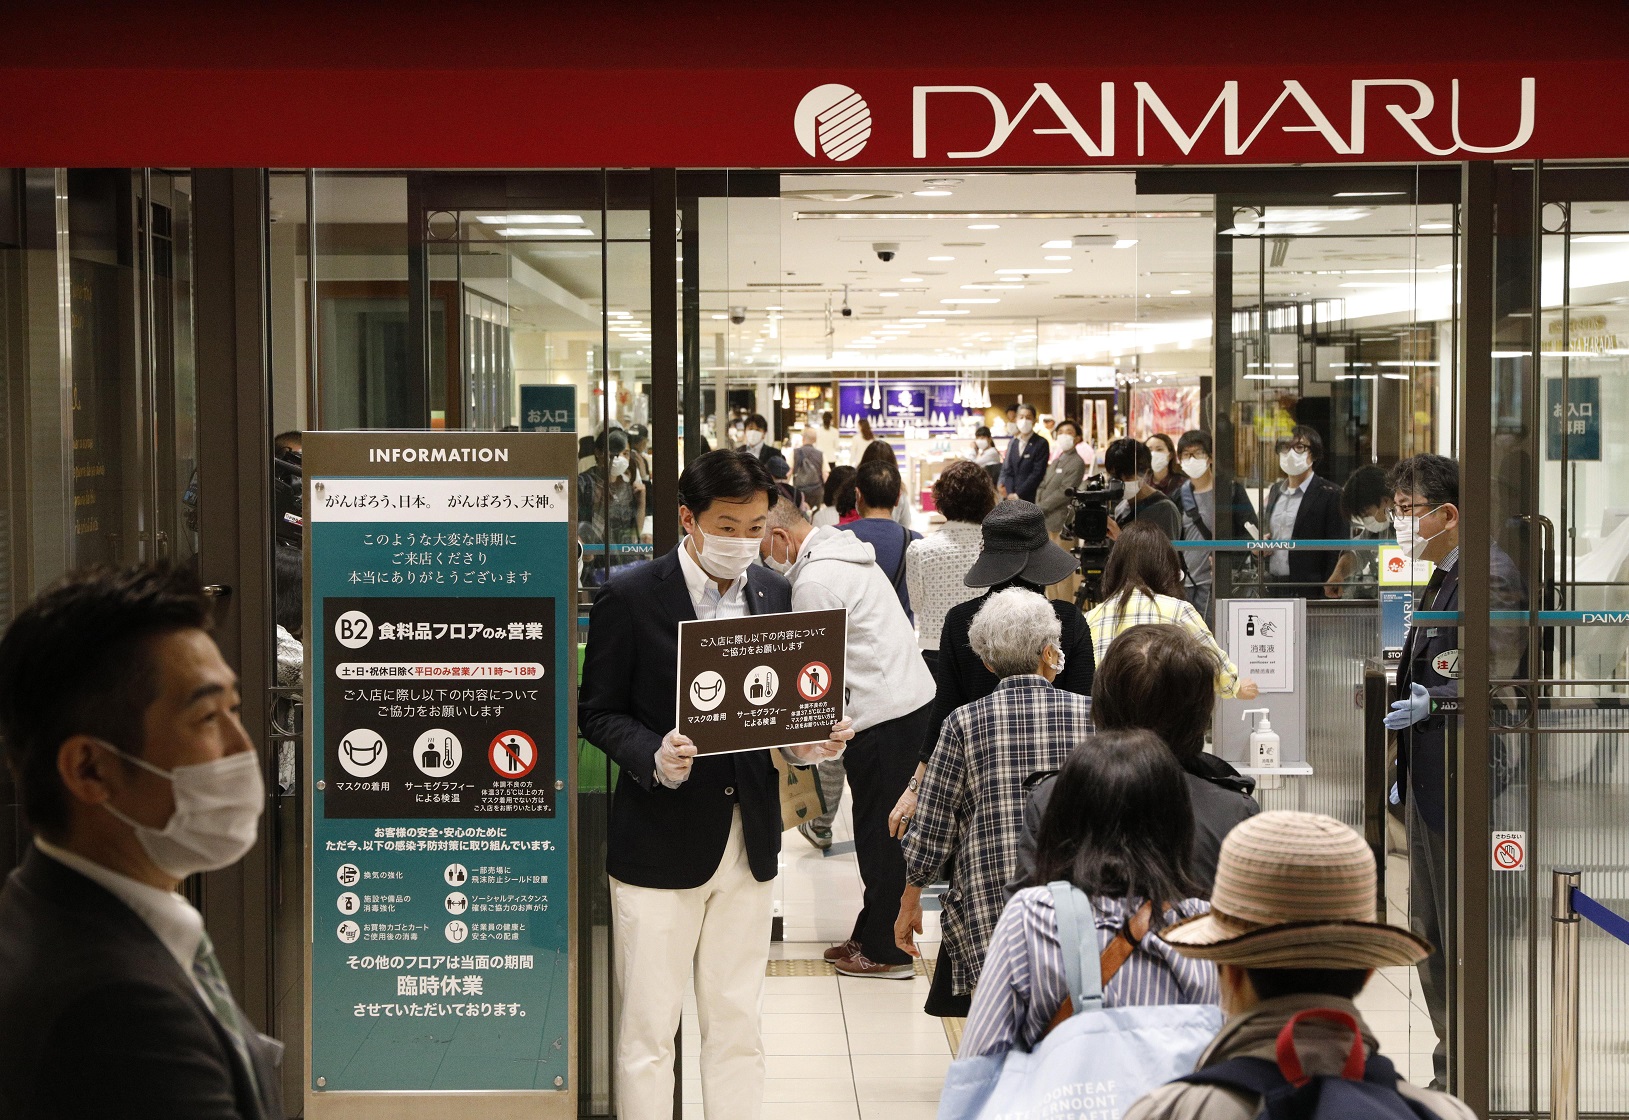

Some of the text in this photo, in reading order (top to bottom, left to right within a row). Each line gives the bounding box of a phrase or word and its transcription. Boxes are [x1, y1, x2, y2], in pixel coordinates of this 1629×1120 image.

[913, 77, 1536, 158] DAIMARU
[528, 410, 568, 423] お入口
[369, 448, 508, 462] INFORMATION
[326, 495, 554, 509] がんばろう、日本。 がんばろう、天神。
[364, 533, 517, 546] このような大変な時期に
[391, 552, 487, 565] ご来店くださり
[348, 571, 532, 584] 本当にありがとうございます
[341, 619, 543, 640] B2 食料品フロアのみ営業
[700, 628, 826, 647] ご入店に際し以下の内容について
[722, 641, 804, 657] ご協力をお願いします
[1250, 644, 1275, 653] 消毒液
[344, 689, 538, 702] ご入店に際し以下の内容について
[378, 705, 505, 717] ご協力をお願いします
[736, 707, 787, 718] サーモグラフィー
[687, 713, 727, 723] マスクの着用
[744, 718, 777, 728] による検温
[336, 782, 390, 791] マスクの着用
[405, 782, 474, 791] サーモグラフィー
[415, 793, 460, 803] による検温
[374, 827, 507, 838] お客様の安全・安心のために
[326, 840, 555, 851] ただ今、以下の感染予防対策に取り組んでいます。
[472, 866, 511, 874] 一部売場に
[363, 895, 411, 903] 施設や備品の
[472, 895, 548, 903] ソーシャルディスタンス
[363, 904, 396, 912] 消毒強化
[472, 904, 548, 912] 確保ご協力のお声がけ
[472, 923, 526, 931] 従業員の健康と
[472, 932, 519, 940] 安全への配慮
[346, 955, 533, 970] その他のフロアは当面の期間
[397, 976, 483, 996] 臨時休業
[353, 1003, 526, 1017] させていただいております。
